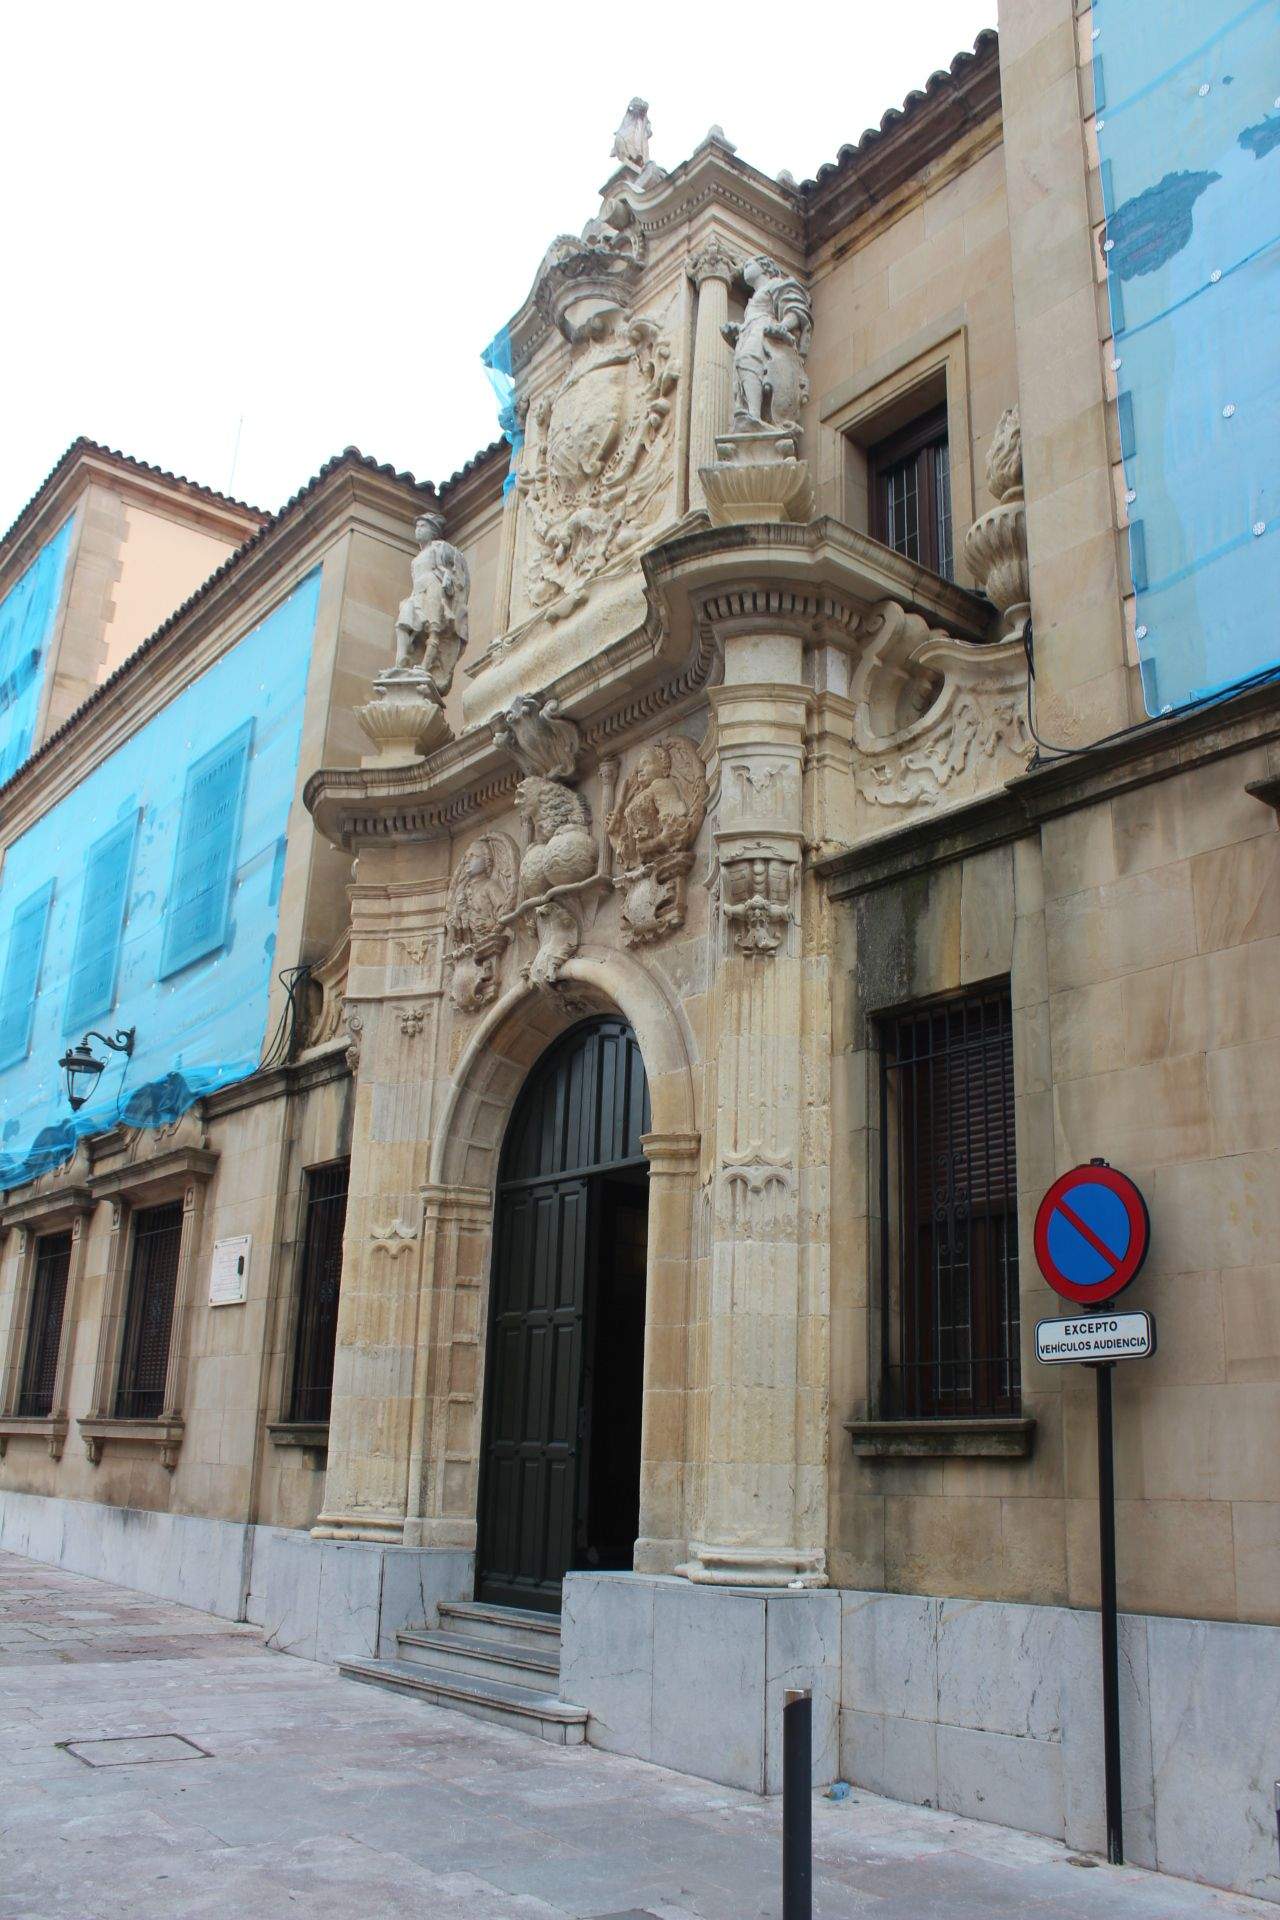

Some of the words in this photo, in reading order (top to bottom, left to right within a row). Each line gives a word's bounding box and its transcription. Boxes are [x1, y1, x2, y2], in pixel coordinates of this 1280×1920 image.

[1064, 1321, 1118, 1336] EXCEPTO
[1040, 1340, 1092, 1354] VEHÍCULOS
[1093, 1336, 1147, 1350] AUDIENCIA
